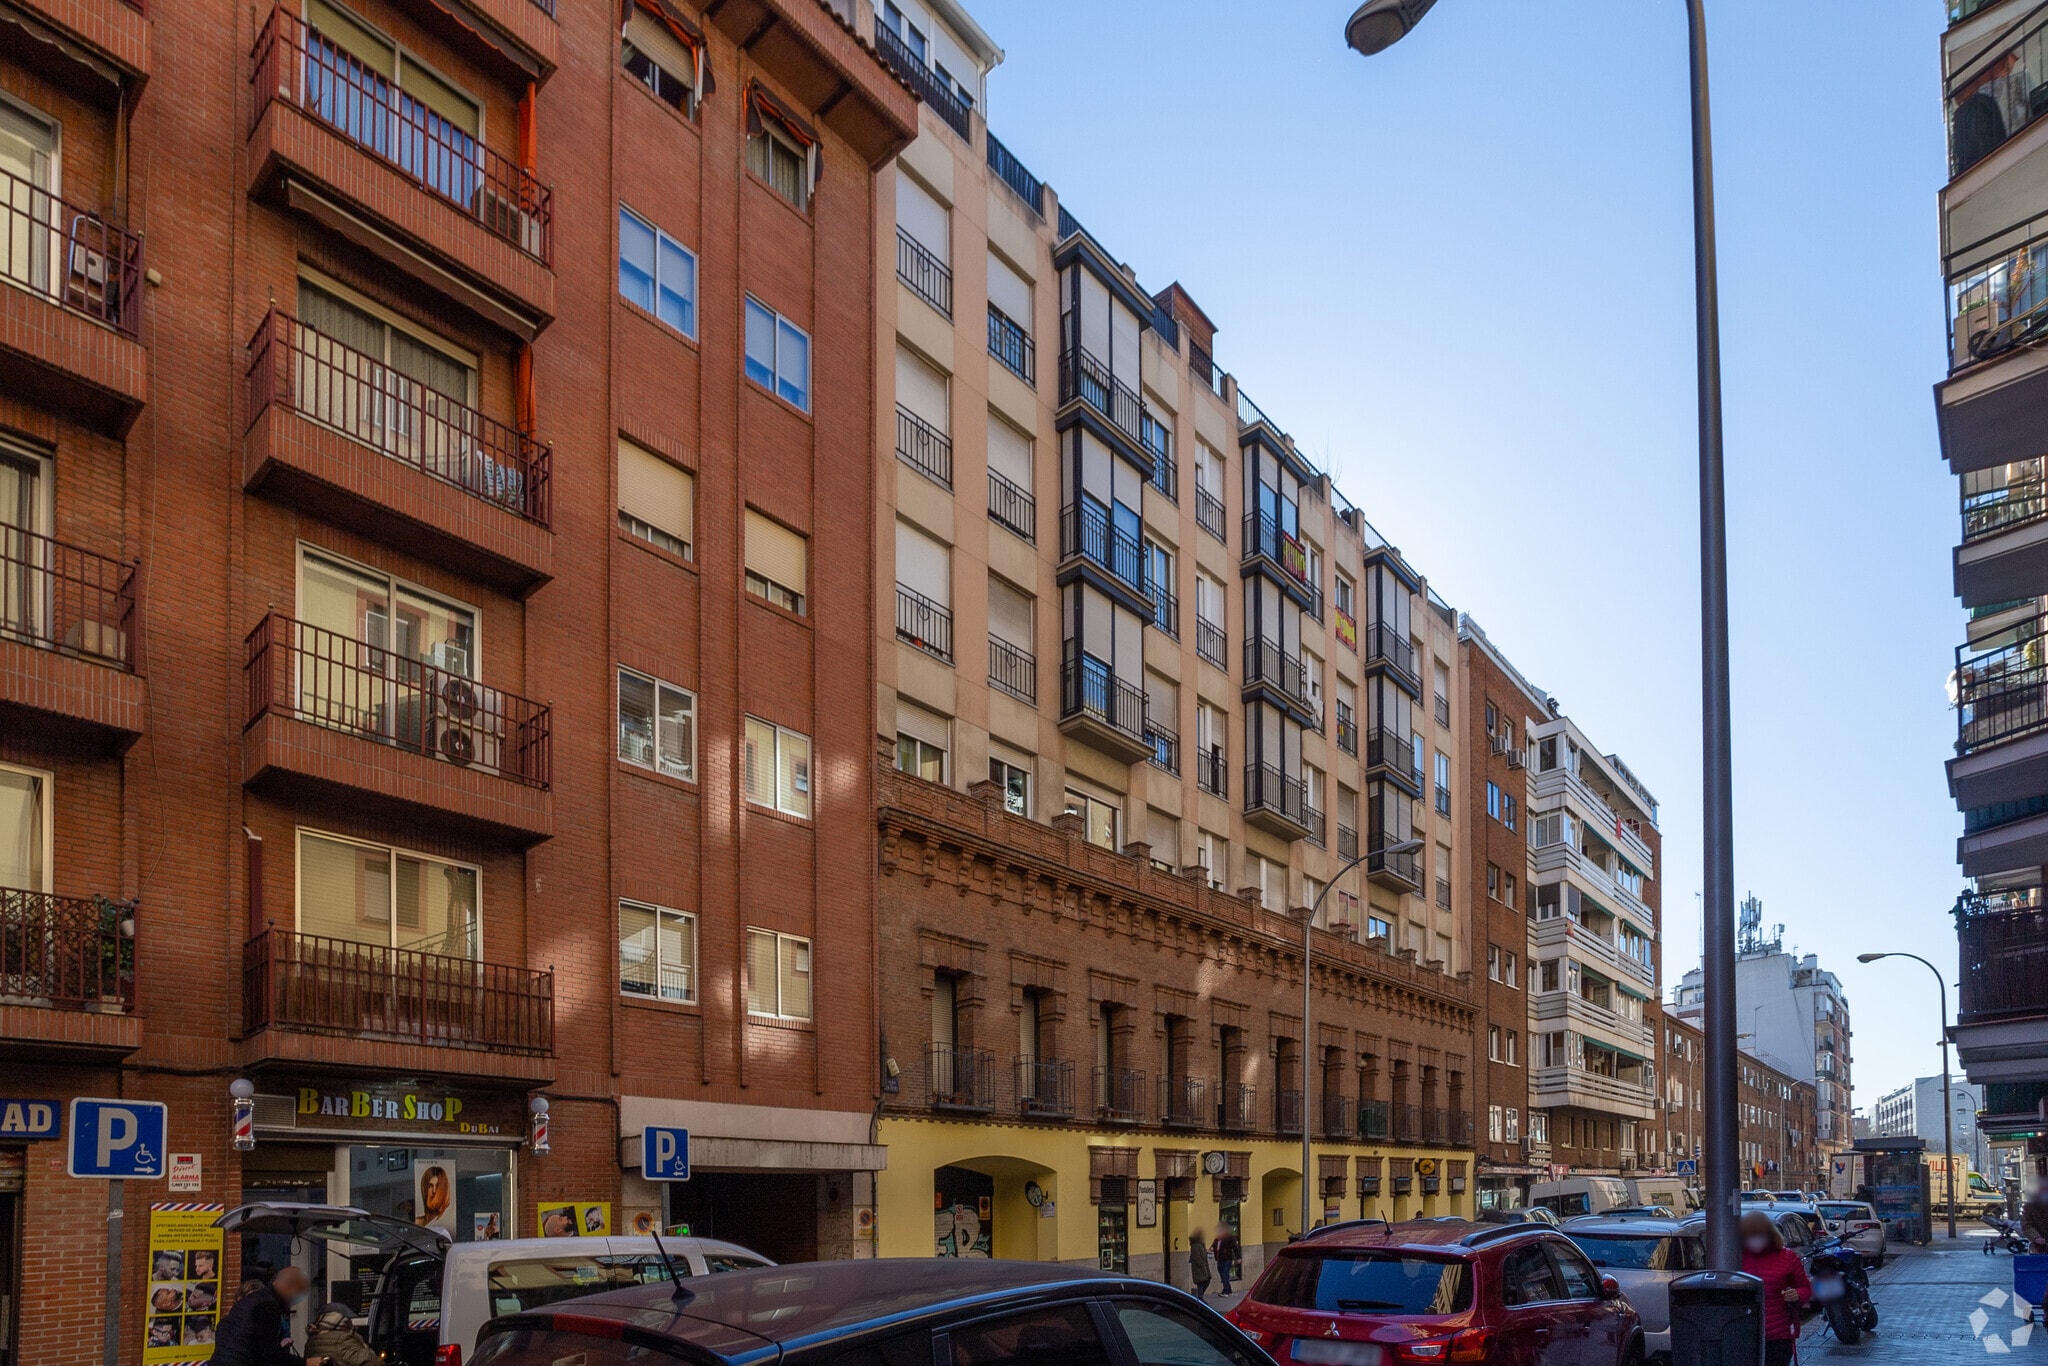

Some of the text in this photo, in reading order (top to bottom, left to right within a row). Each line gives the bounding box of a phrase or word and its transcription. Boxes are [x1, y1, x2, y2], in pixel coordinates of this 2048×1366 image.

[1, 1103, 52, 1132] AD
[97, 1107, 138, 1168] P
[656, 1130, 676, 1173] P
